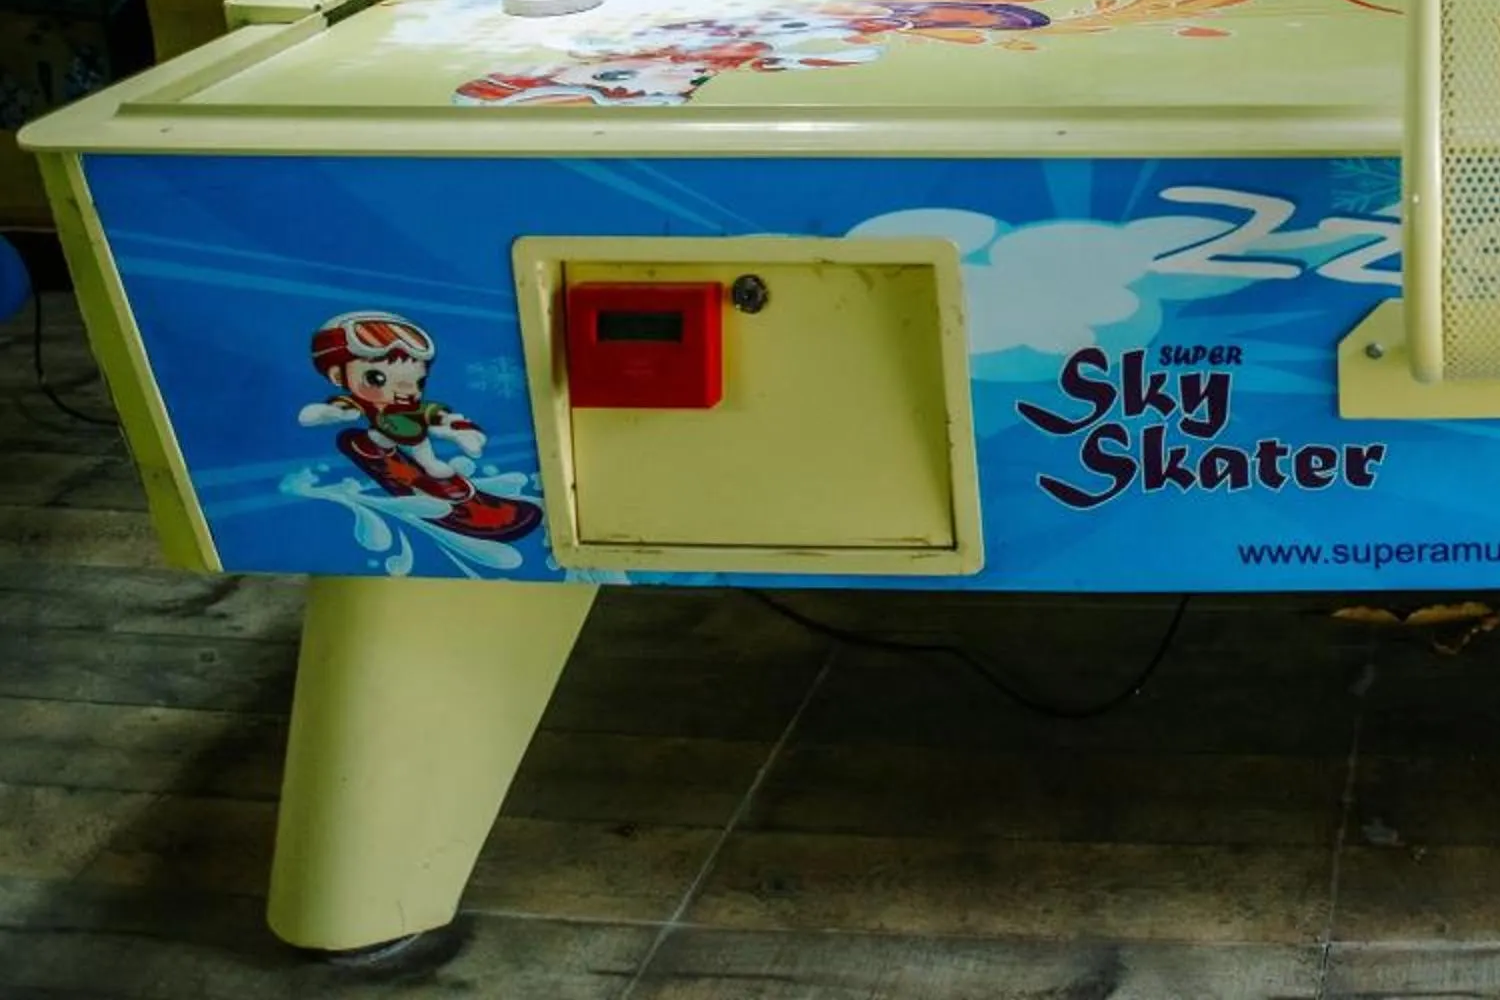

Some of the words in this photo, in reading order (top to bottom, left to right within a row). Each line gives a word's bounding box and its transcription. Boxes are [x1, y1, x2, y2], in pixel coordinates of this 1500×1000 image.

[1016, 347, 1231, 440] Sky
[1159, 345, 1243, 366] SUPER
[1037, 423, 1387, 510] Skater
